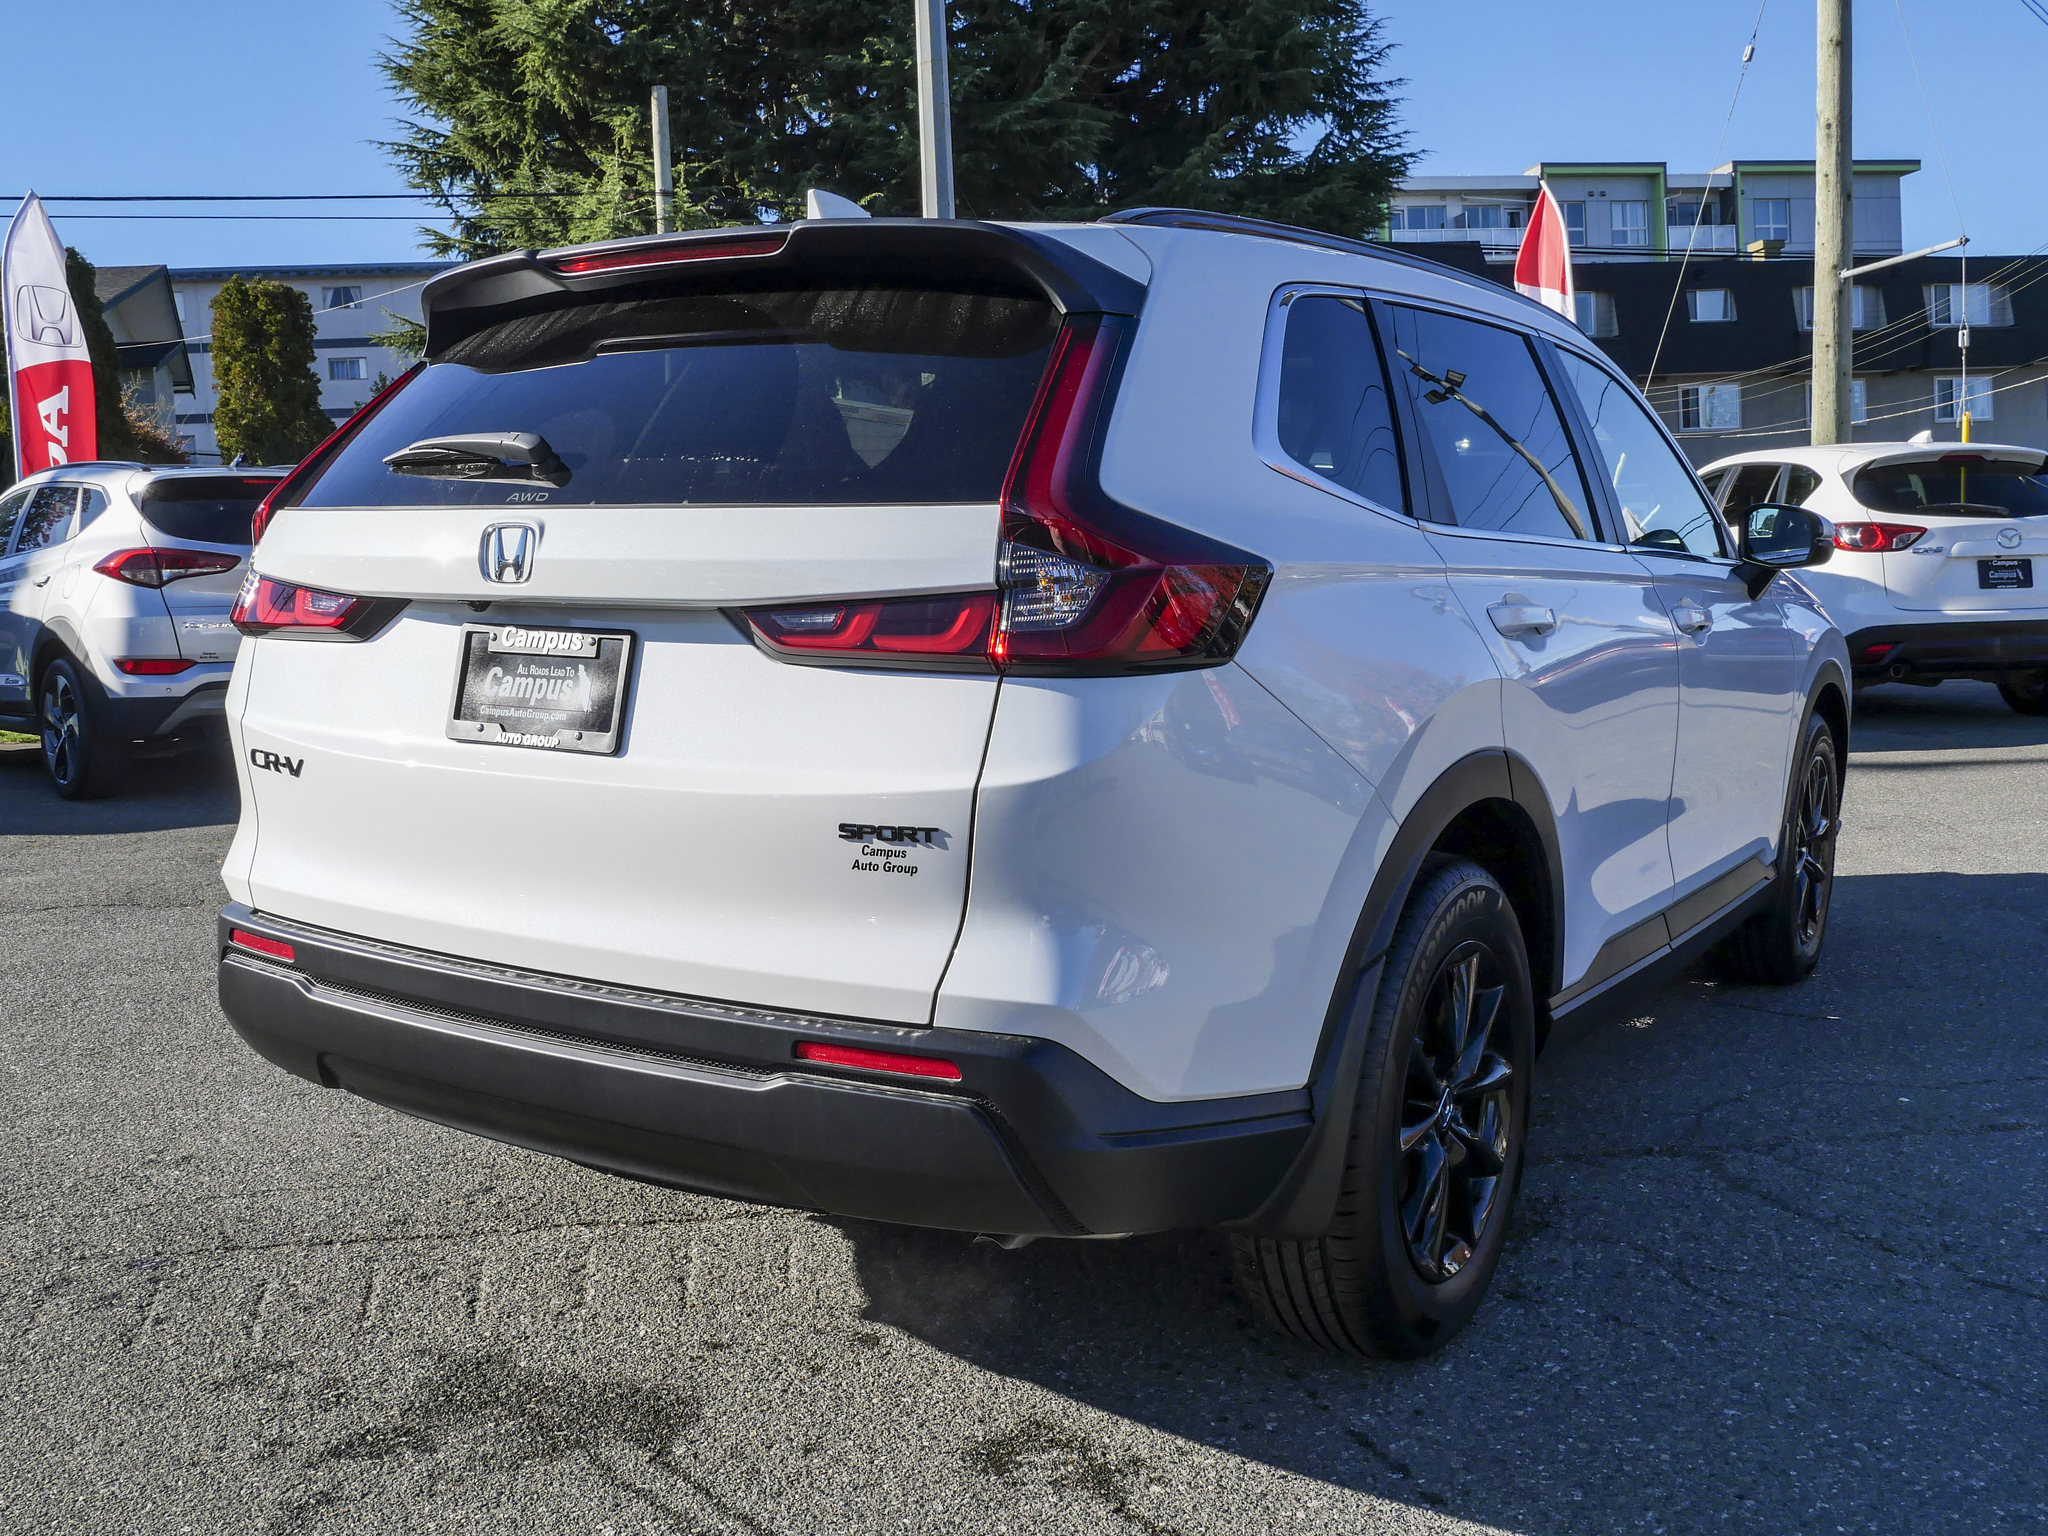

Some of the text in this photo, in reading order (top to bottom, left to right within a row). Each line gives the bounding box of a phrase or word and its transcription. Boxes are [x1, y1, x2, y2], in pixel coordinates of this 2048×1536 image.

[506, 492, 549, 502] AWD
[182, 620, 234, 629] TUCSON
[502, 626, 585, 655] Campus
[484, 666, 574, 706] Campus
[480, 705, 567, 721] CampusAutoGroup.com
[494, 732, 560, 748] AUTO GROUP
[250, 748, 305, 778] CR-V
[838, 822, 939, 843] SPORT
[861, 844, 907, 860] Campus
[851, 859, 918, 877] Auto Group
